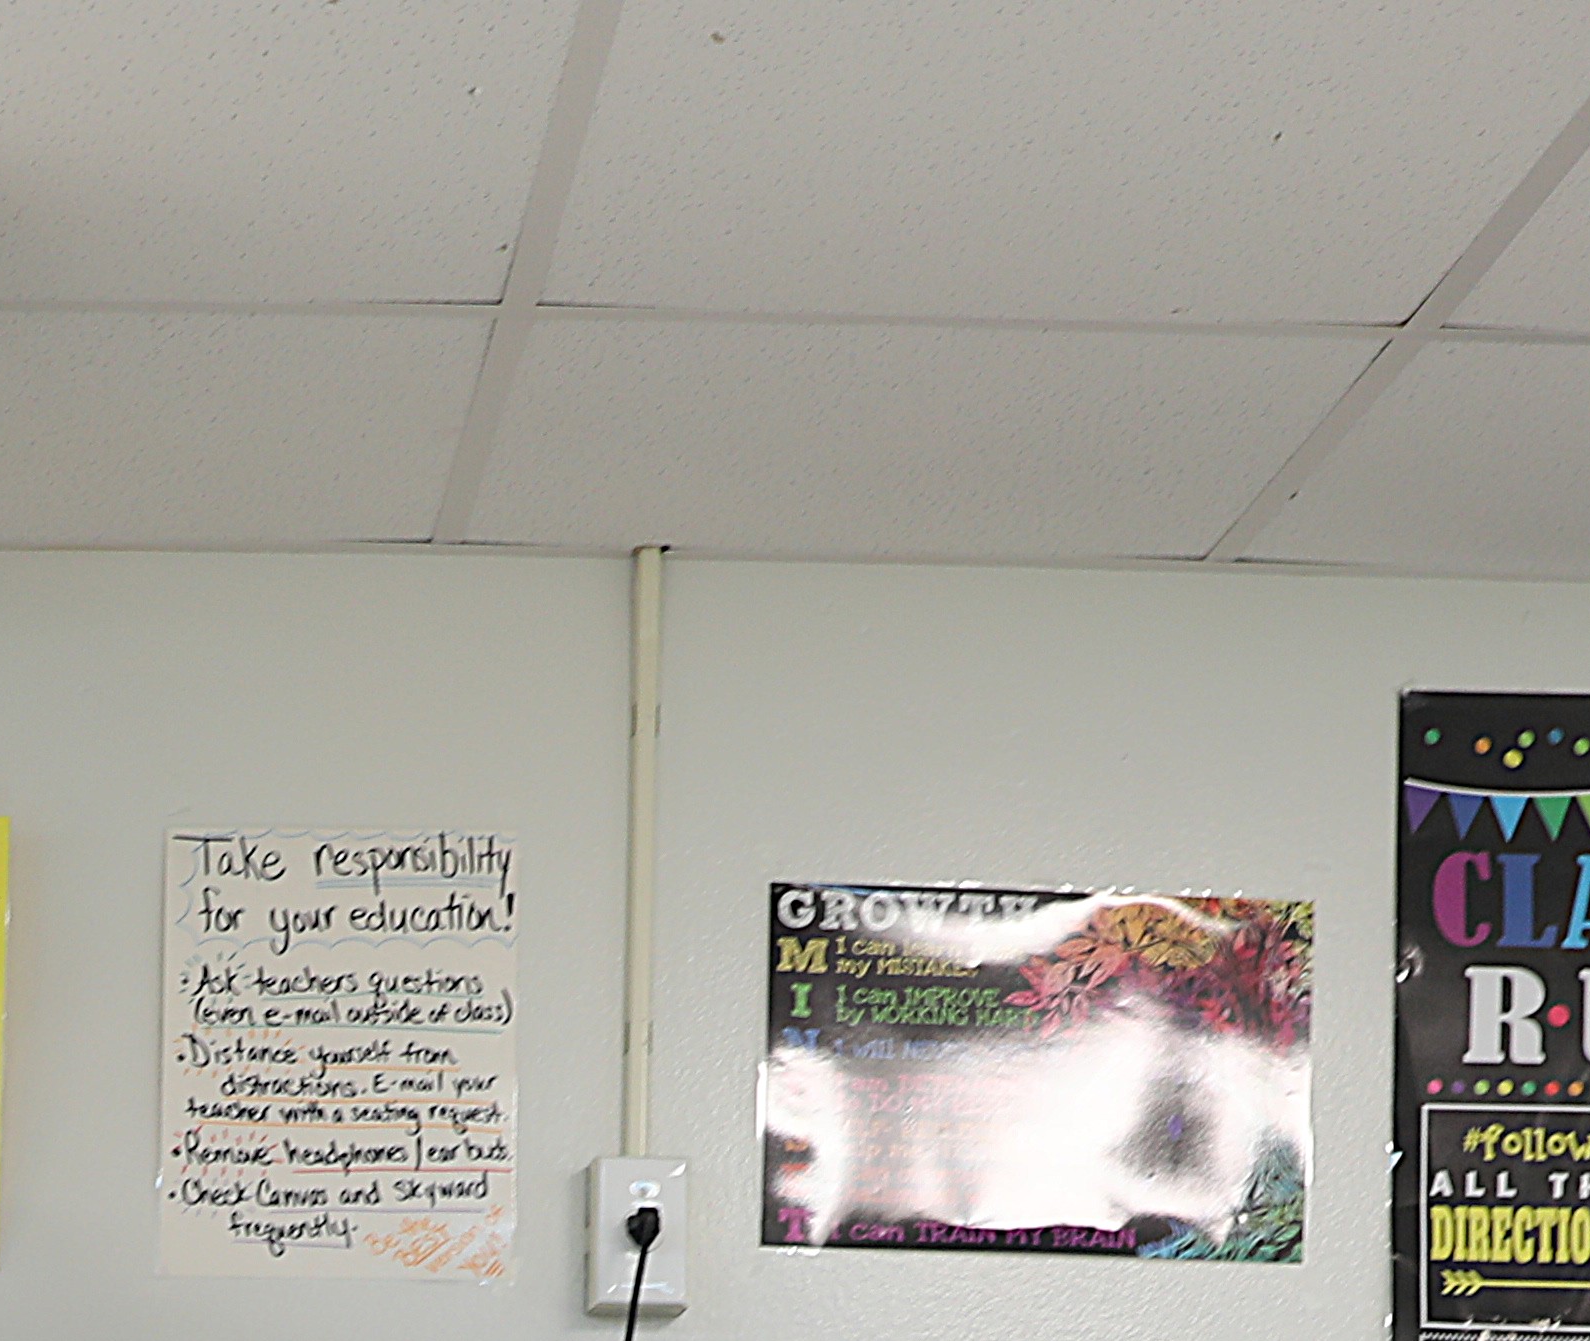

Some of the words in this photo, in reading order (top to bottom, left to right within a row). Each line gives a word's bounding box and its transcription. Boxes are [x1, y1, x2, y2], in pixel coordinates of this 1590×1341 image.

[173, 835, 286, 881] Take
[316, 834, 511, 896] responsibility
[198, 887, 242, 933] for
[269, 906, 337, 955] your
[349, 893, 516, 933] education!
[776, 936, 830, 974] M
[852, 939, 897, 957] can
[191, 964, 242, 998] Ask
[252, 965, 359, 997] teachers
[370, 970, 483, 1004] questions
[790, 982, 813, 1018] I
[265, 999, 340, 1026] e-mail
[183, 1033, 298, 1067] Distance
[310, 1039, 391, 1079] yourself
[400, 1040, 458, 1066] from
[374, 1069, 444, 1096] E-mail
[451, 1073, 498, 1100] your
[186, 1098, 272, 1123] teacher
[280, 1100, 326, 1124] with
[352, 1100, 421, 1136] seating
[183, 1130, 273, 1167] Remove
[181, 1178, 250, 1206] Check
[255, 1177, 328, 1207] Canvas
[339, 1180, 381, 1205] and
[1429, 1170, 1518, 1199] ALL
[849, 1222, 905, 1242] can
